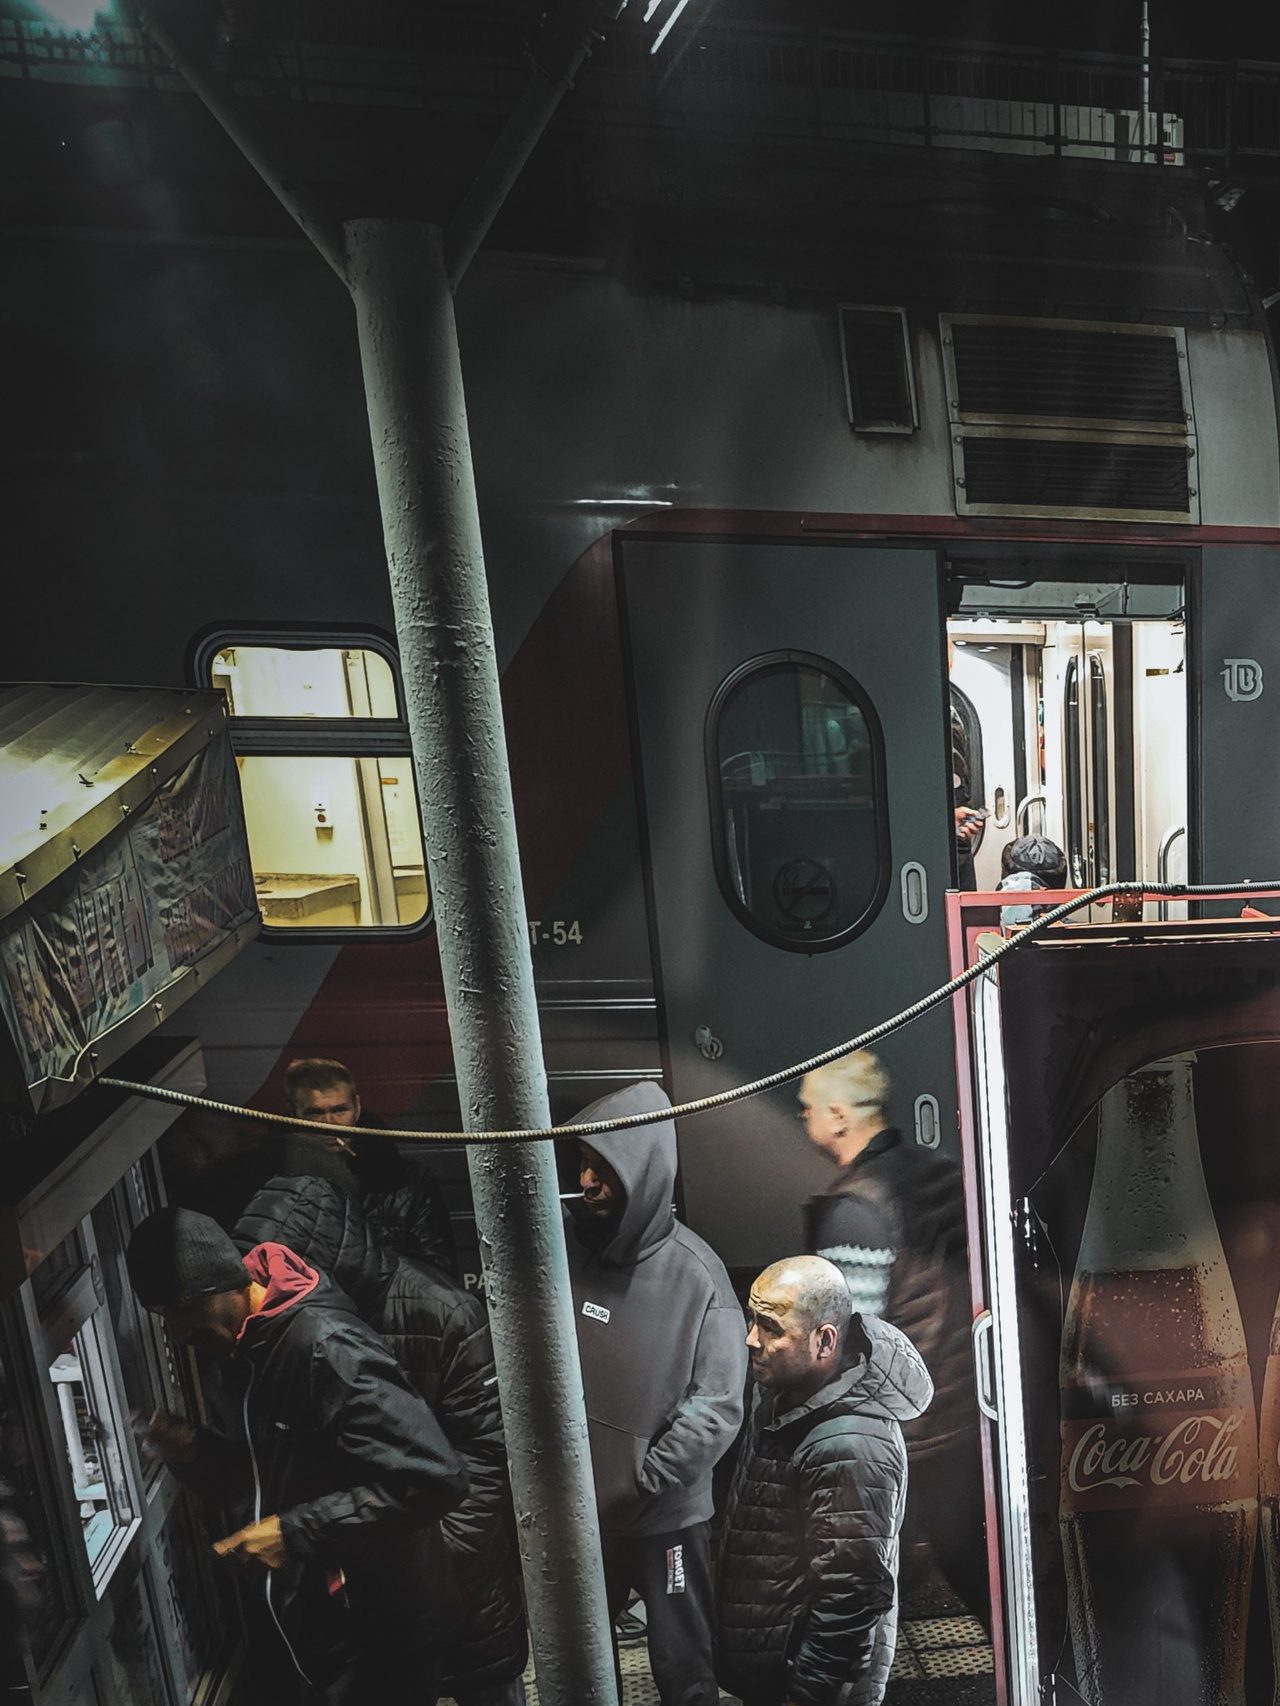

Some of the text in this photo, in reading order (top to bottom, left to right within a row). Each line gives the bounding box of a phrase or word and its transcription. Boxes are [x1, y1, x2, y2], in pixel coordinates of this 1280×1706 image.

[529, 920, 583, 945] Т-54
[585, 1304, 608, 1319] CRUSH
[1111, 1388, 1205, 1407] БЕЗ САХАРА
[1068, 1413, 1244, 1492] Coca-Cola
